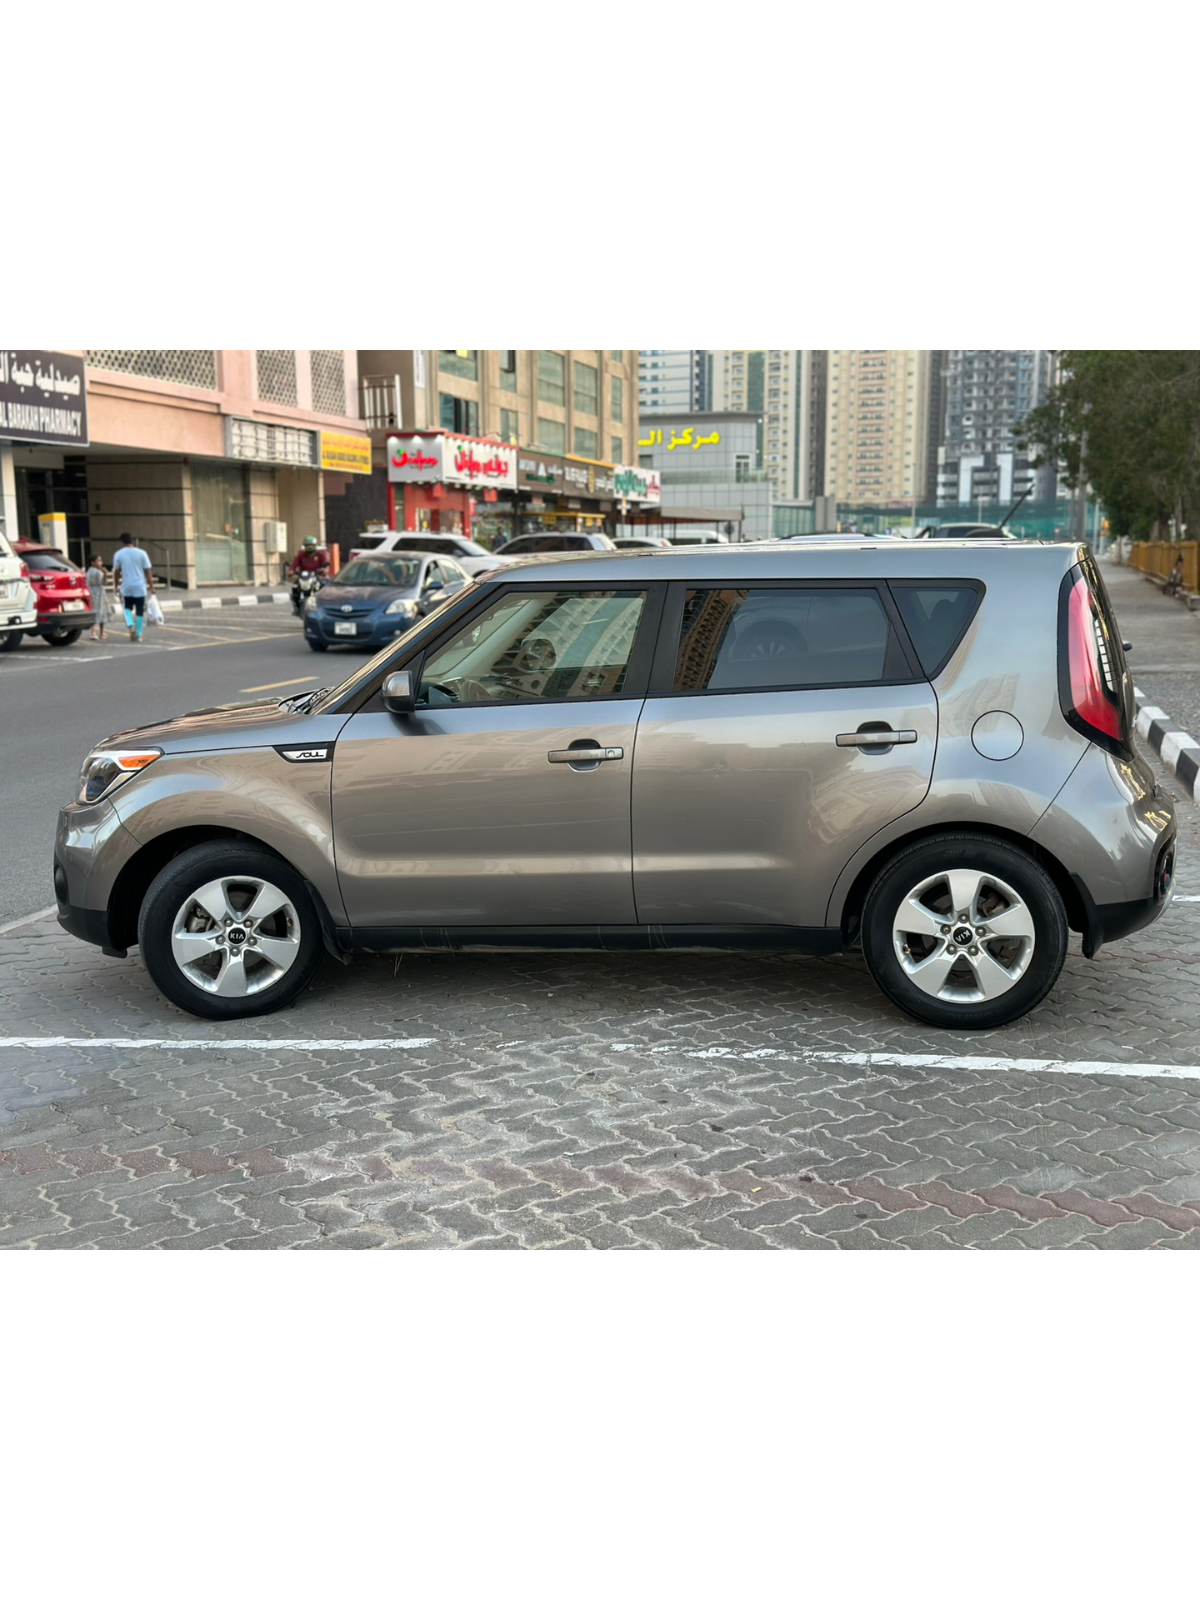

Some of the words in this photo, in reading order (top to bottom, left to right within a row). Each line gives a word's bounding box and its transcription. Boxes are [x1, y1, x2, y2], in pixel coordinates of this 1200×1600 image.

[11, 352, 34, 393] حبة
[36, 360, 80, 400] صيدلية
[39, 406, 81, 437] PHARMACY
[667, 427, 720, 451] مركز
[230, 932, 244, 940] KIA
[955, 930, 970, 942] KIA
